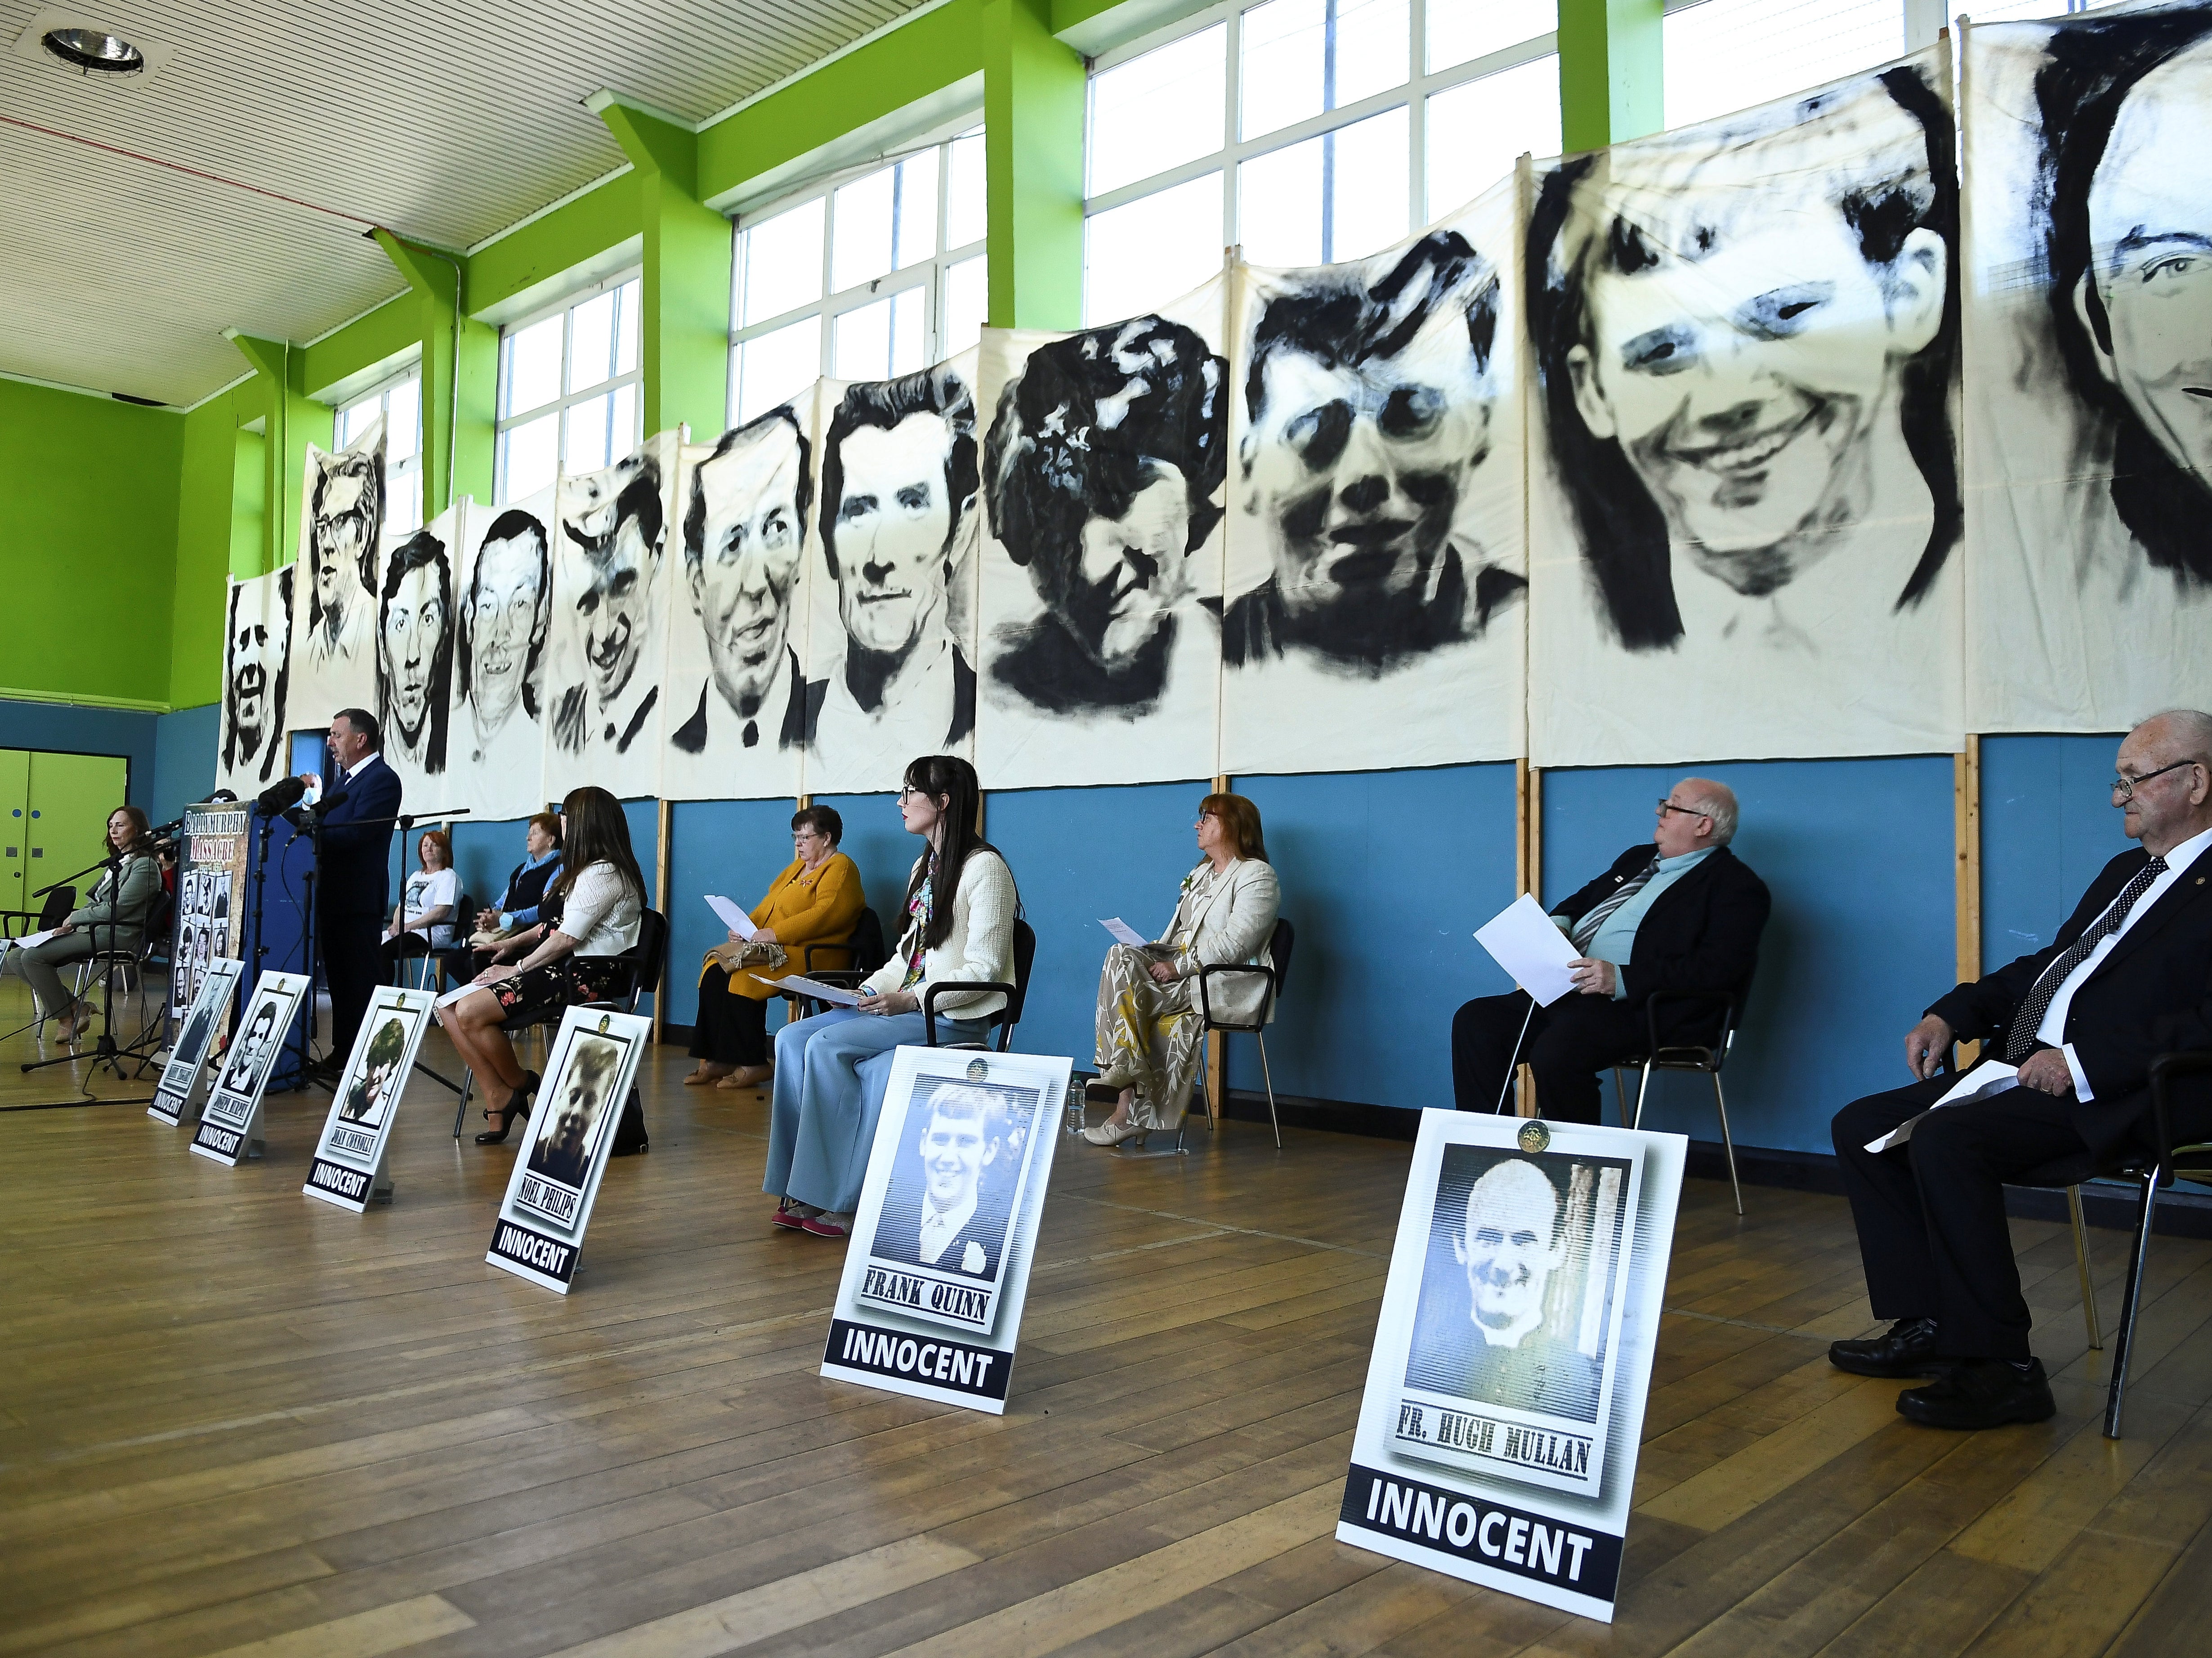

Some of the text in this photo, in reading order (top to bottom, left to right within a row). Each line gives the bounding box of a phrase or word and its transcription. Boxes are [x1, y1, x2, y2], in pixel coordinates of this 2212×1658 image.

[184, 811, 246, 835] BALLYMURPHY
[191, 837, 234, 861] MASSACRE
[154, 1091, 183, 1115] INNOCENT
[198, 1125, 240, 1153] INNOCENT
[313, 1162, 367, 1197] INNOCENT
[518, 1177, 576, 1219] NOEL PHILIPS
[498, 1225, 569, 1274] INNOCENT
[862, 1269, 990, 1320] FRANK QUINN
[842, 1328, 993, 1388] INNOCENT
[1396, 1403, 1591, 1475] FR. HUGH MULLAN
[1366, 1479, 1593, 1582] INNOCENT
